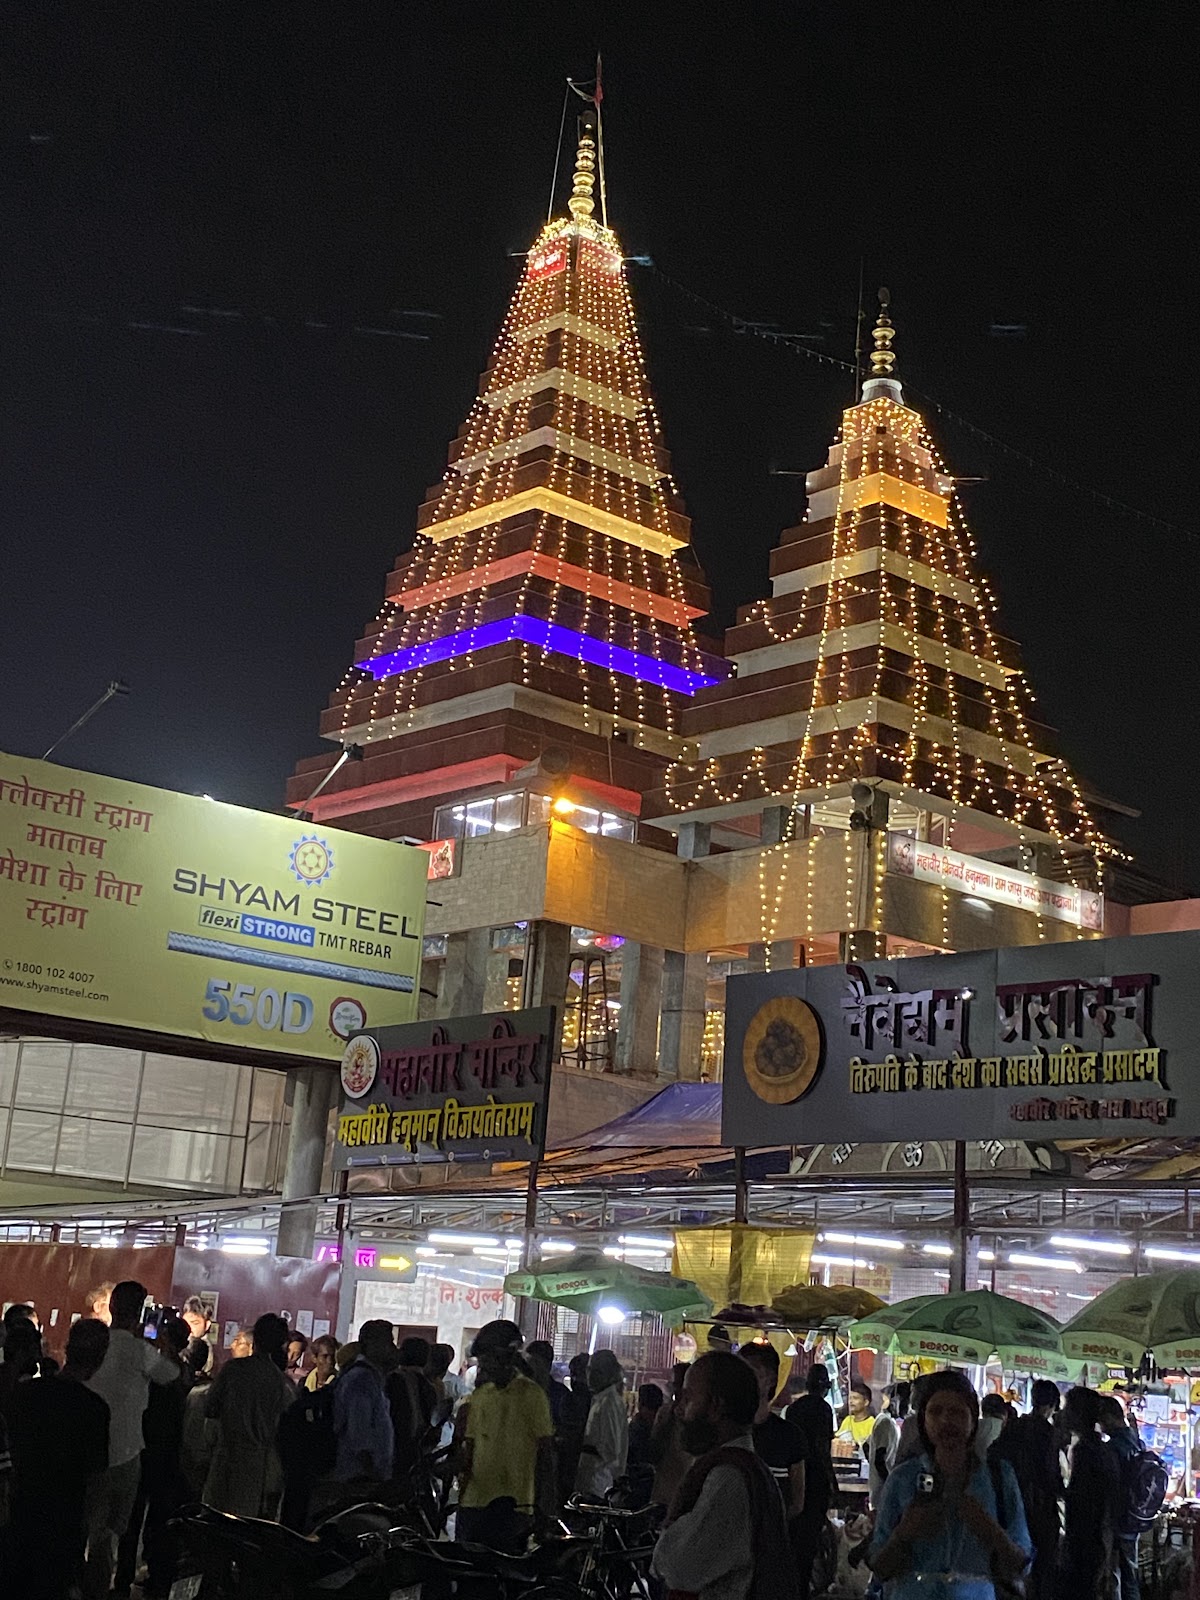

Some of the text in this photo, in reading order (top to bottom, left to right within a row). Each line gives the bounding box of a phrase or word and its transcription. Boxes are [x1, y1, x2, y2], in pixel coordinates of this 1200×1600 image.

[94, 800, 154, 833] स्ट्रांग
[27, 823, 107, 860] मतलब
[58, 861, 87, 893] के
[95, 870, 143, 906] लिए
[173, 868, 419, 940] SHYAM STEEL
[26, 896, 89, 930] स्ट्रांग
[202, 909, 392, 960] flexi STRONG TMT REBAR
[16, 961, 95, 984] 1800 102 4007
[202, 977, 314, 1035] 550D
[378, 1025, 466, 1100] महावीर
[904, 1052, 919, 1090] के
[922, 1059, 949, 1090] बाद
[952, 1051, 976, 1088] देश
[981, 1056, 1001, 1087] का
[1006, 1046, 1044, 1085] सबसे
[919, 1340, 959, 1354] BEDROCK
